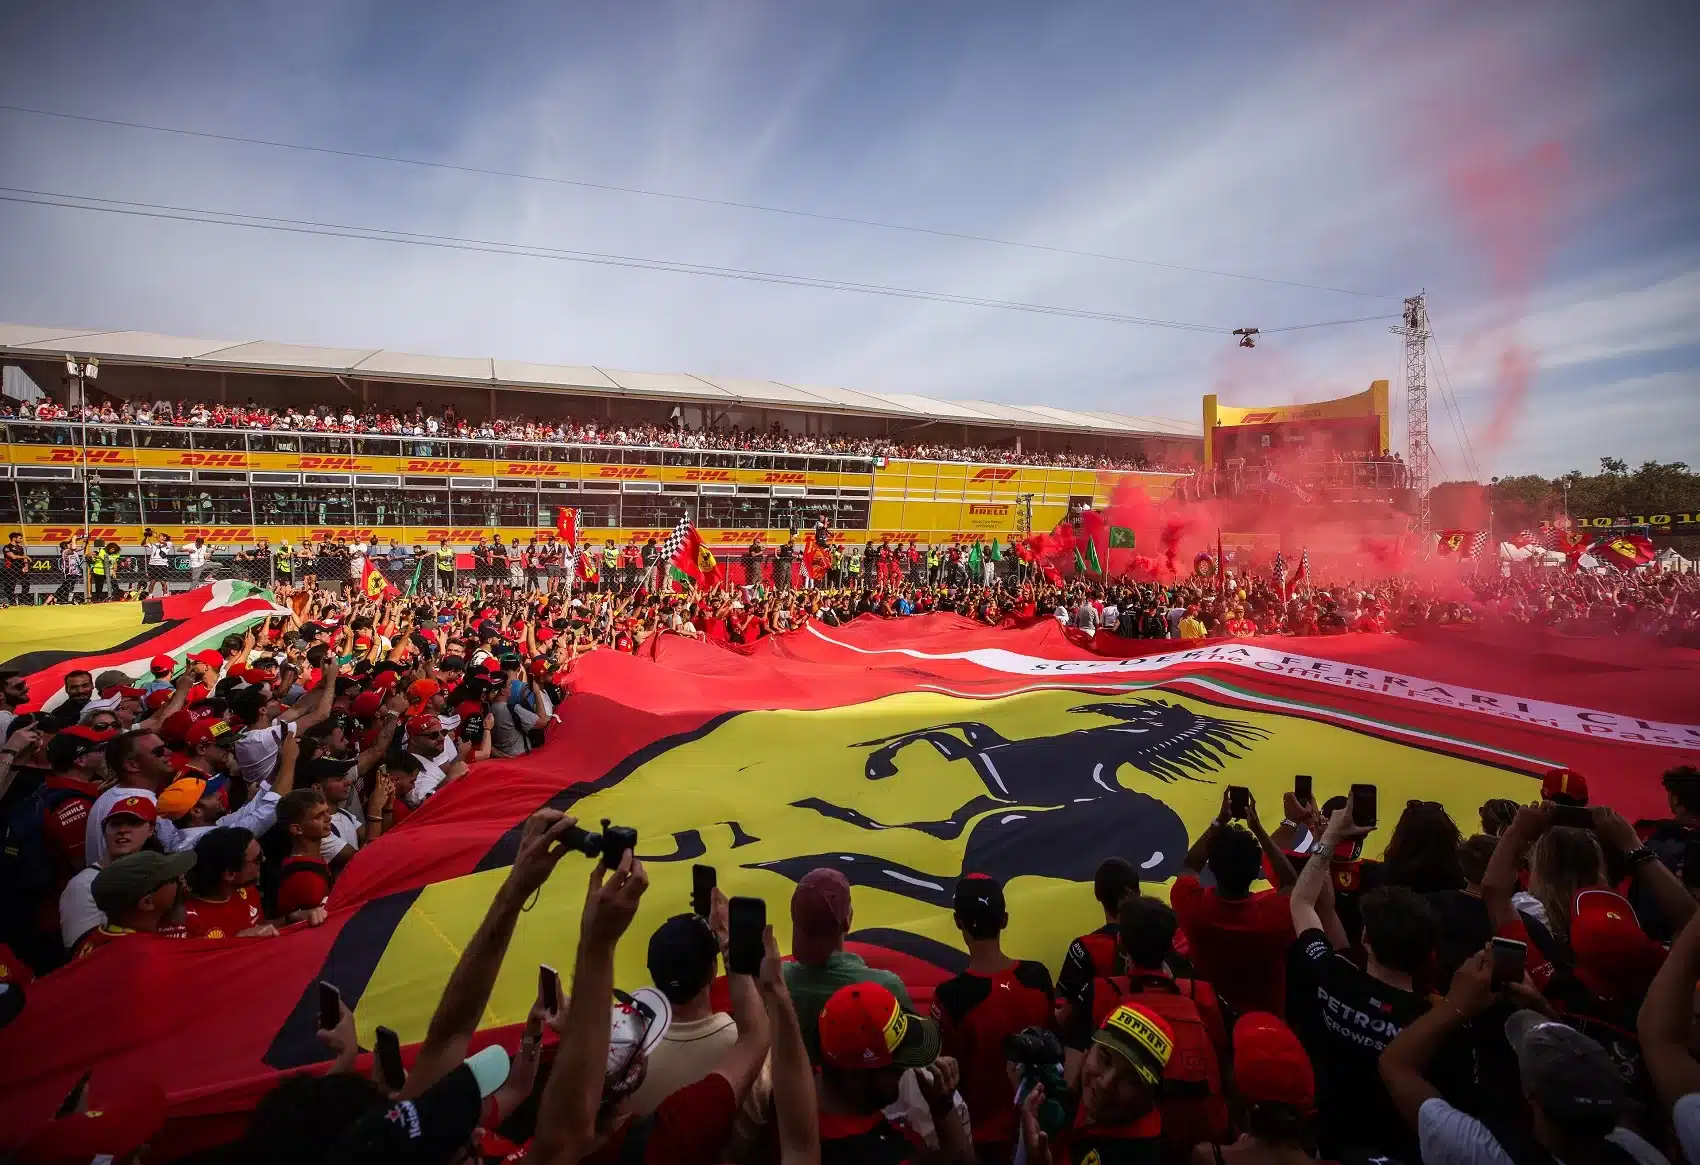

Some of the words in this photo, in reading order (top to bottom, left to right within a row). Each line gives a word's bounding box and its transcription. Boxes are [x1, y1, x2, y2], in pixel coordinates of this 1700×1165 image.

[51, 450, 125, 464] DHL
[180, 453, 249, 466] DHL
[299, 456, 362, 469] DHL
[407, 460, 465, 473] DHL
[506, 464, 561, 476] DHL
[599, 467, 649, 479] DHL
[685, 470, 732, 481] DHL
[764, 472, 807, 483] DHL
[969, 504, 1009, 516] PIRELLI
[42, 528, 123, 541] DHL
[182, 528, 255, 541] DHL
[425, 529, 485, 541] DHL
[720, 532, 768, 542] DHL
[879, 533, 919, 542] DHL
[950, 534, 986, 542] DHL
[1255, 661, 1390, 692] Official
[1280, 656, 1529, 713] FERRARI
[1117, 1011, 1168, 1055] Ferrari
